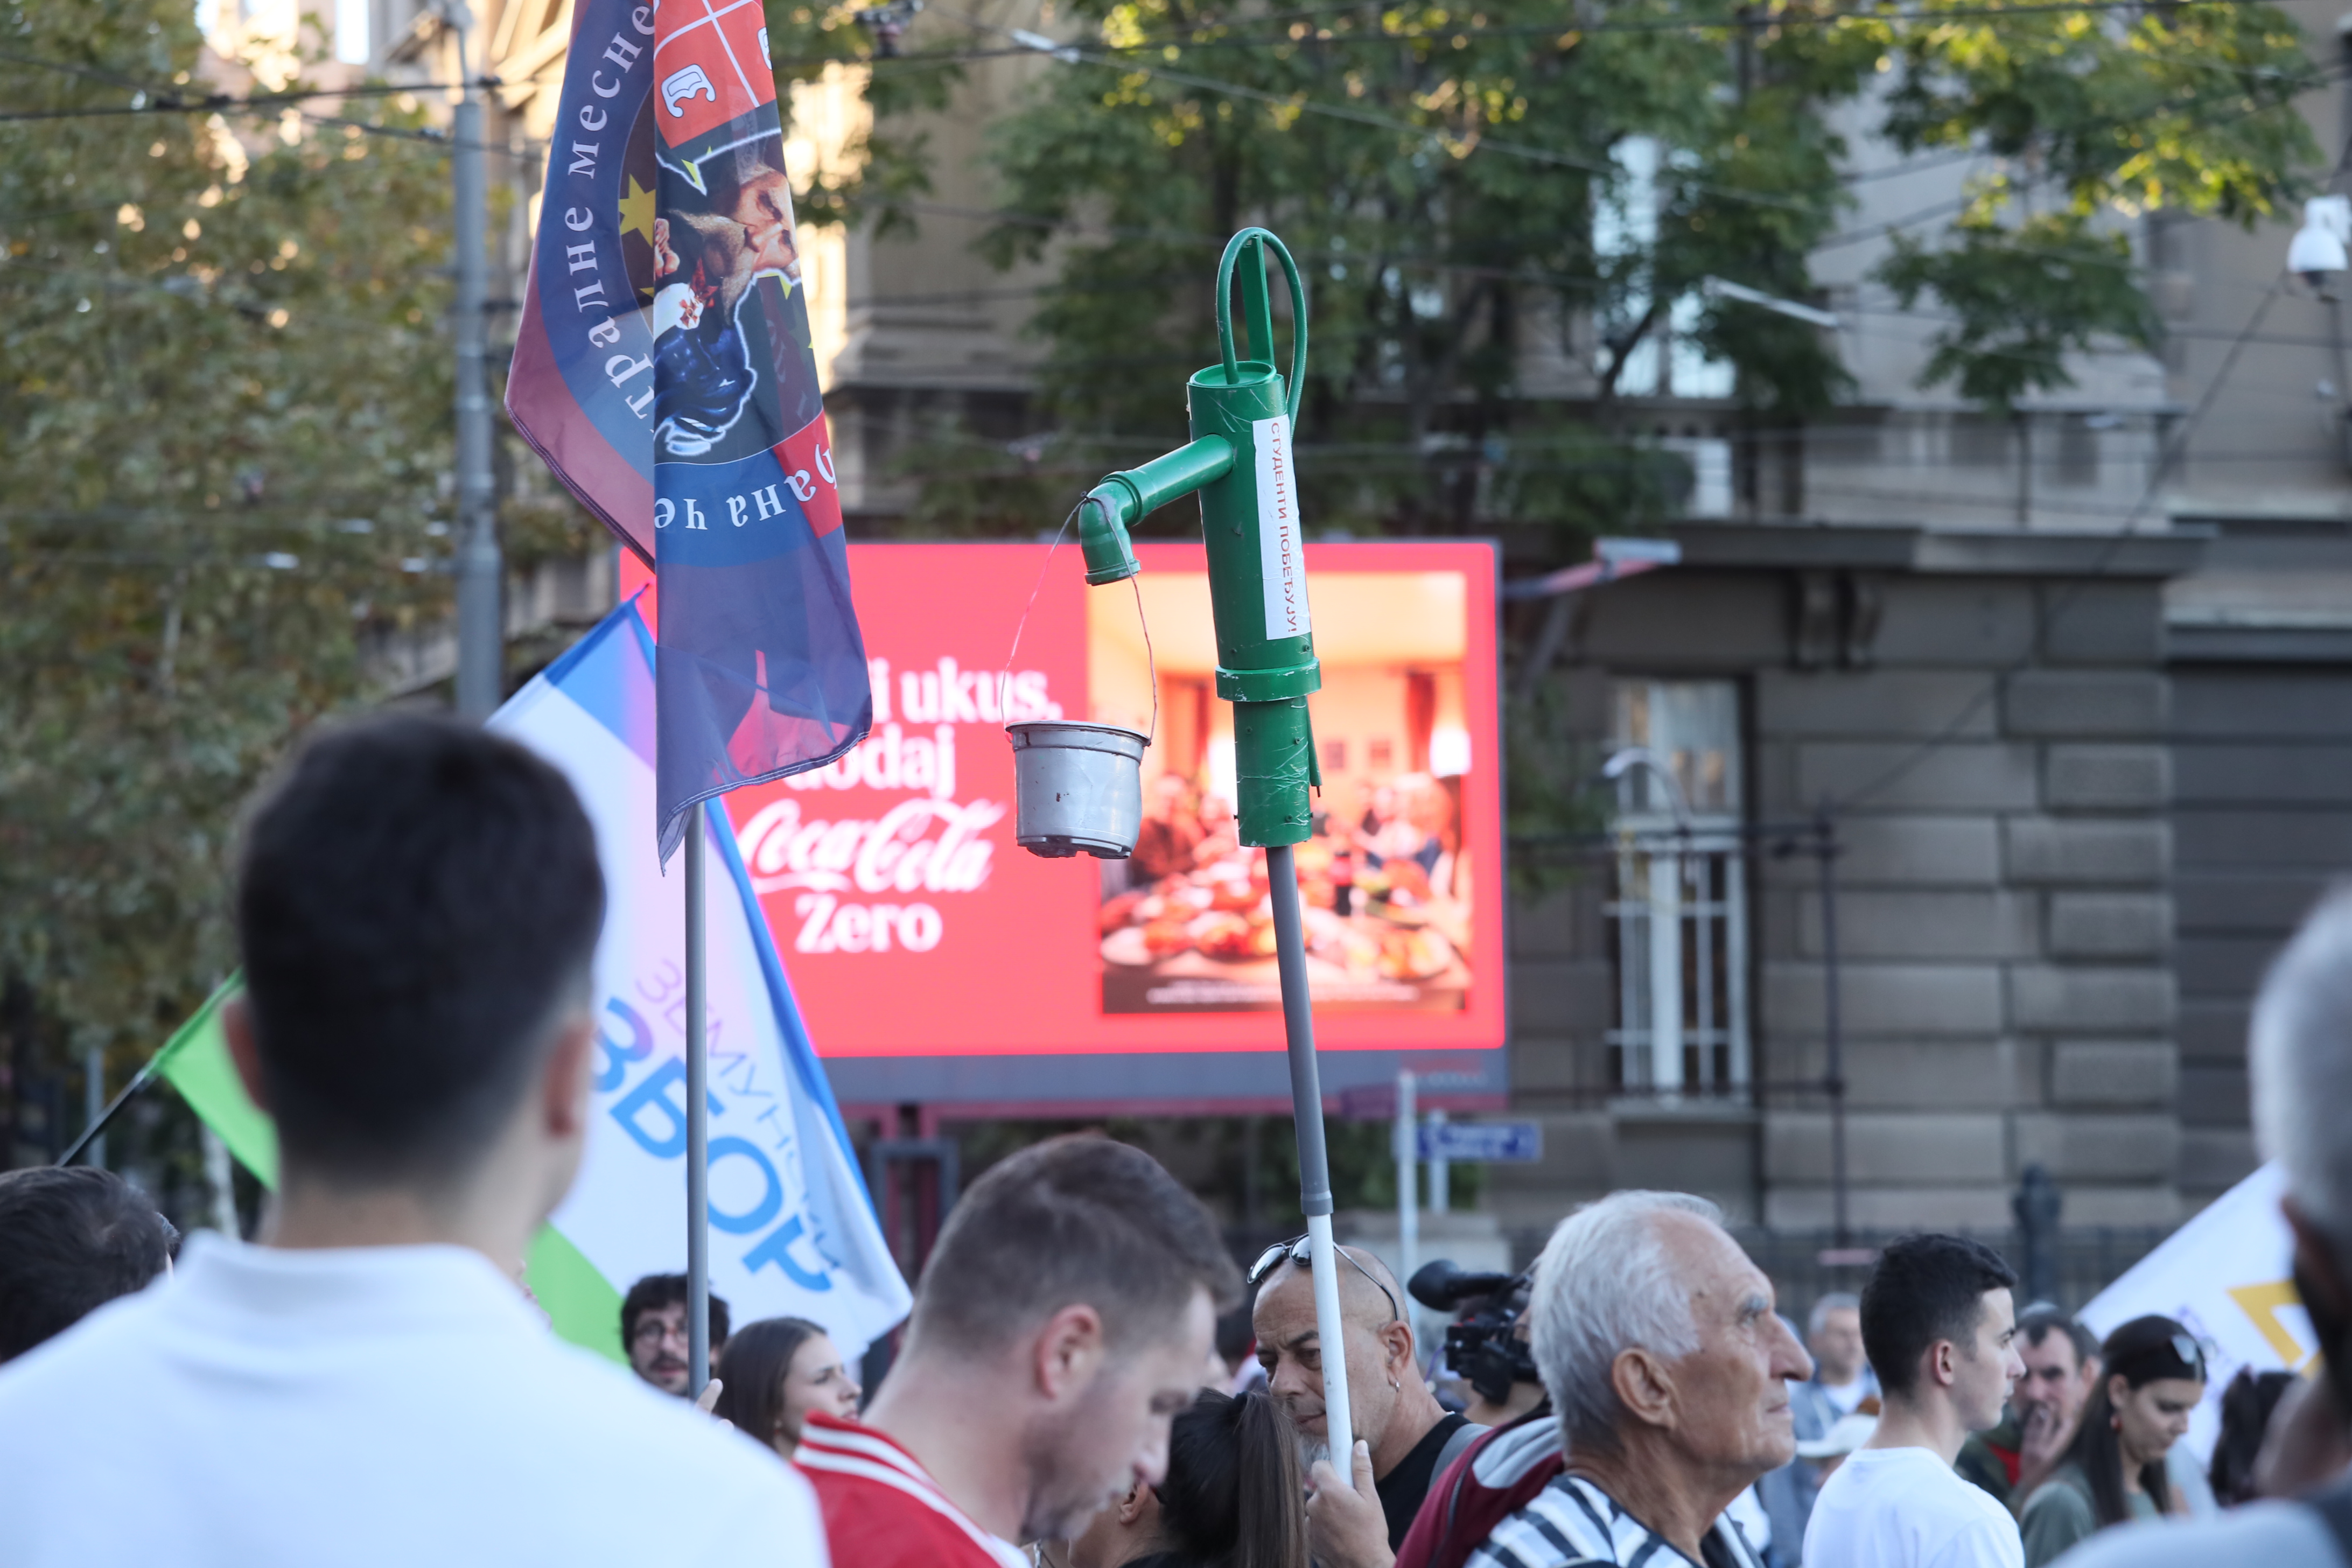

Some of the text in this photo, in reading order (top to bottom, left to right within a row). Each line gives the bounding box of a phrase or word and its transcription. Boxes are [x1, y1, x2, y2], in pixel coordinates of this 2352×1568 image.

[568, 5, 655, 179] месне
[1271, 422, 1287, 520] СТУДЕНТИ
[793, 893, 944, 954] Zero
[594, 996, 834, 1293] ЗБОР
